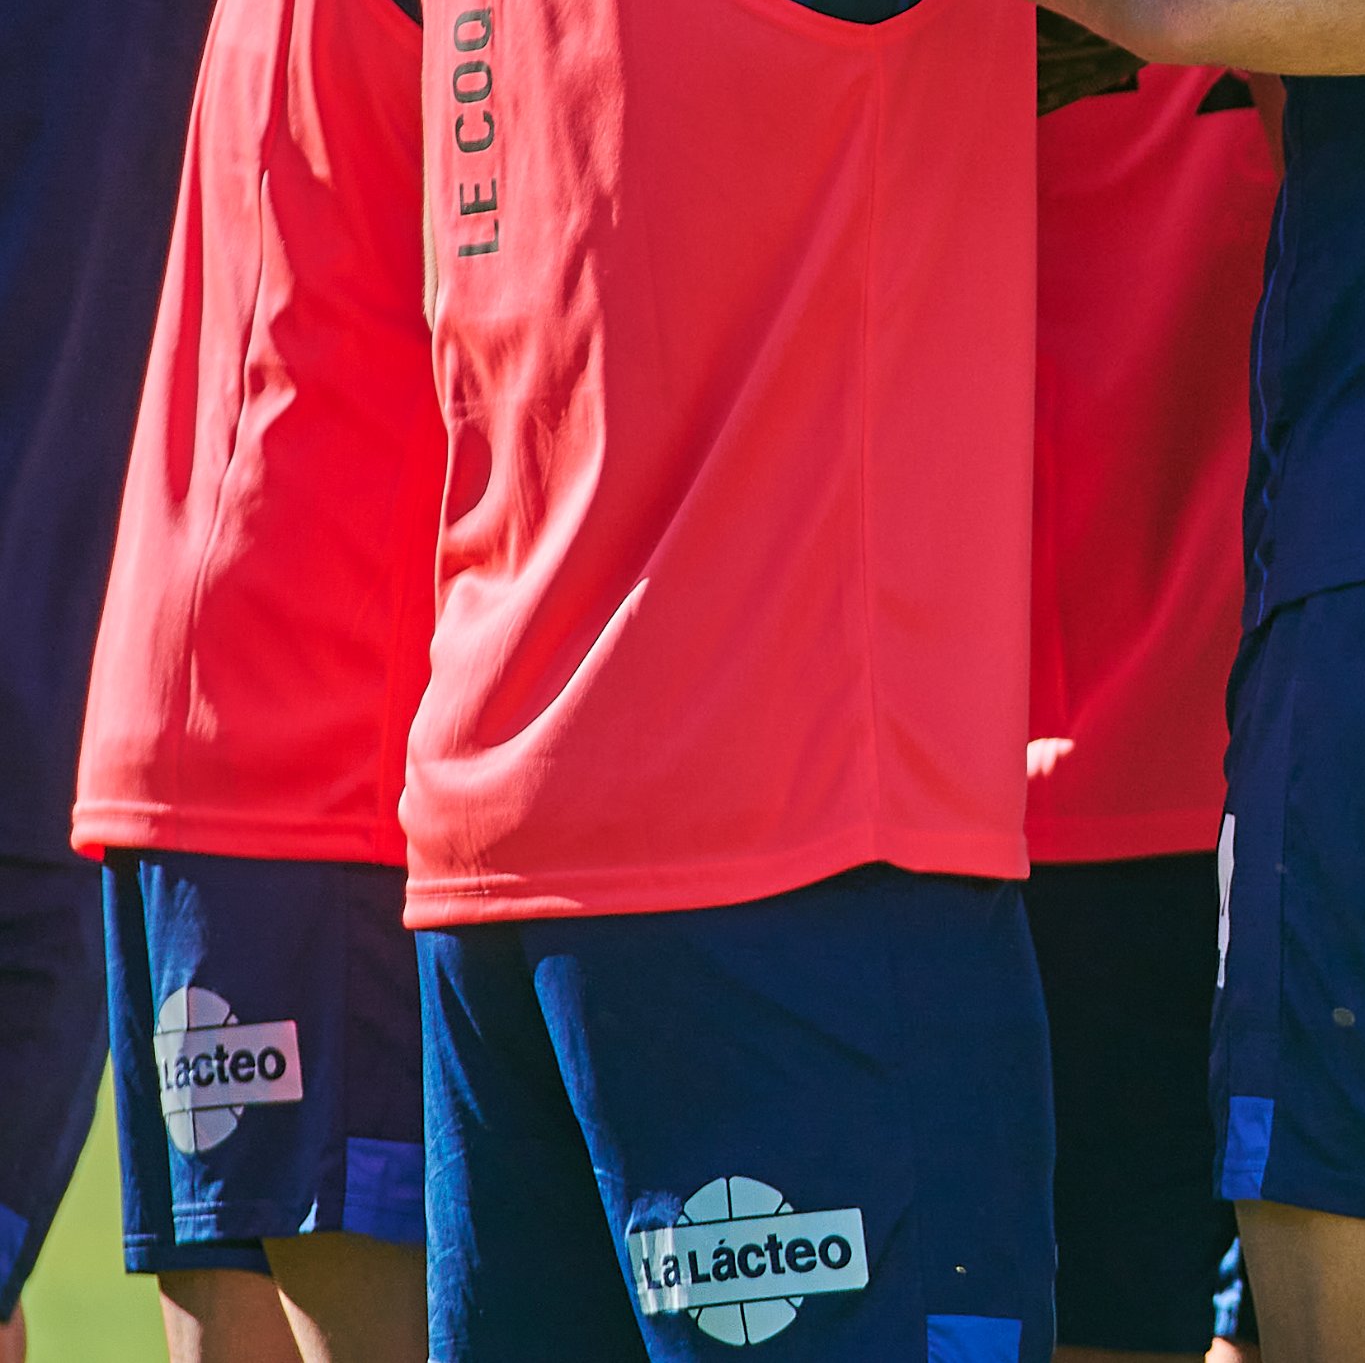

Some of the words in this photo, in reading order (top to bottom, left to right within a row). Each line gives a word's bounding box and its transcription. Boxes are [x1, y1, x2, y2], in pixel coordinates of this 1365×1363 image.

[455, 8, 498, 154] COQ
[457, 178, 500, 258] LE
[641, 1255, 682, 1290] La
[687, 1233, 852, 1284] Lácteo
